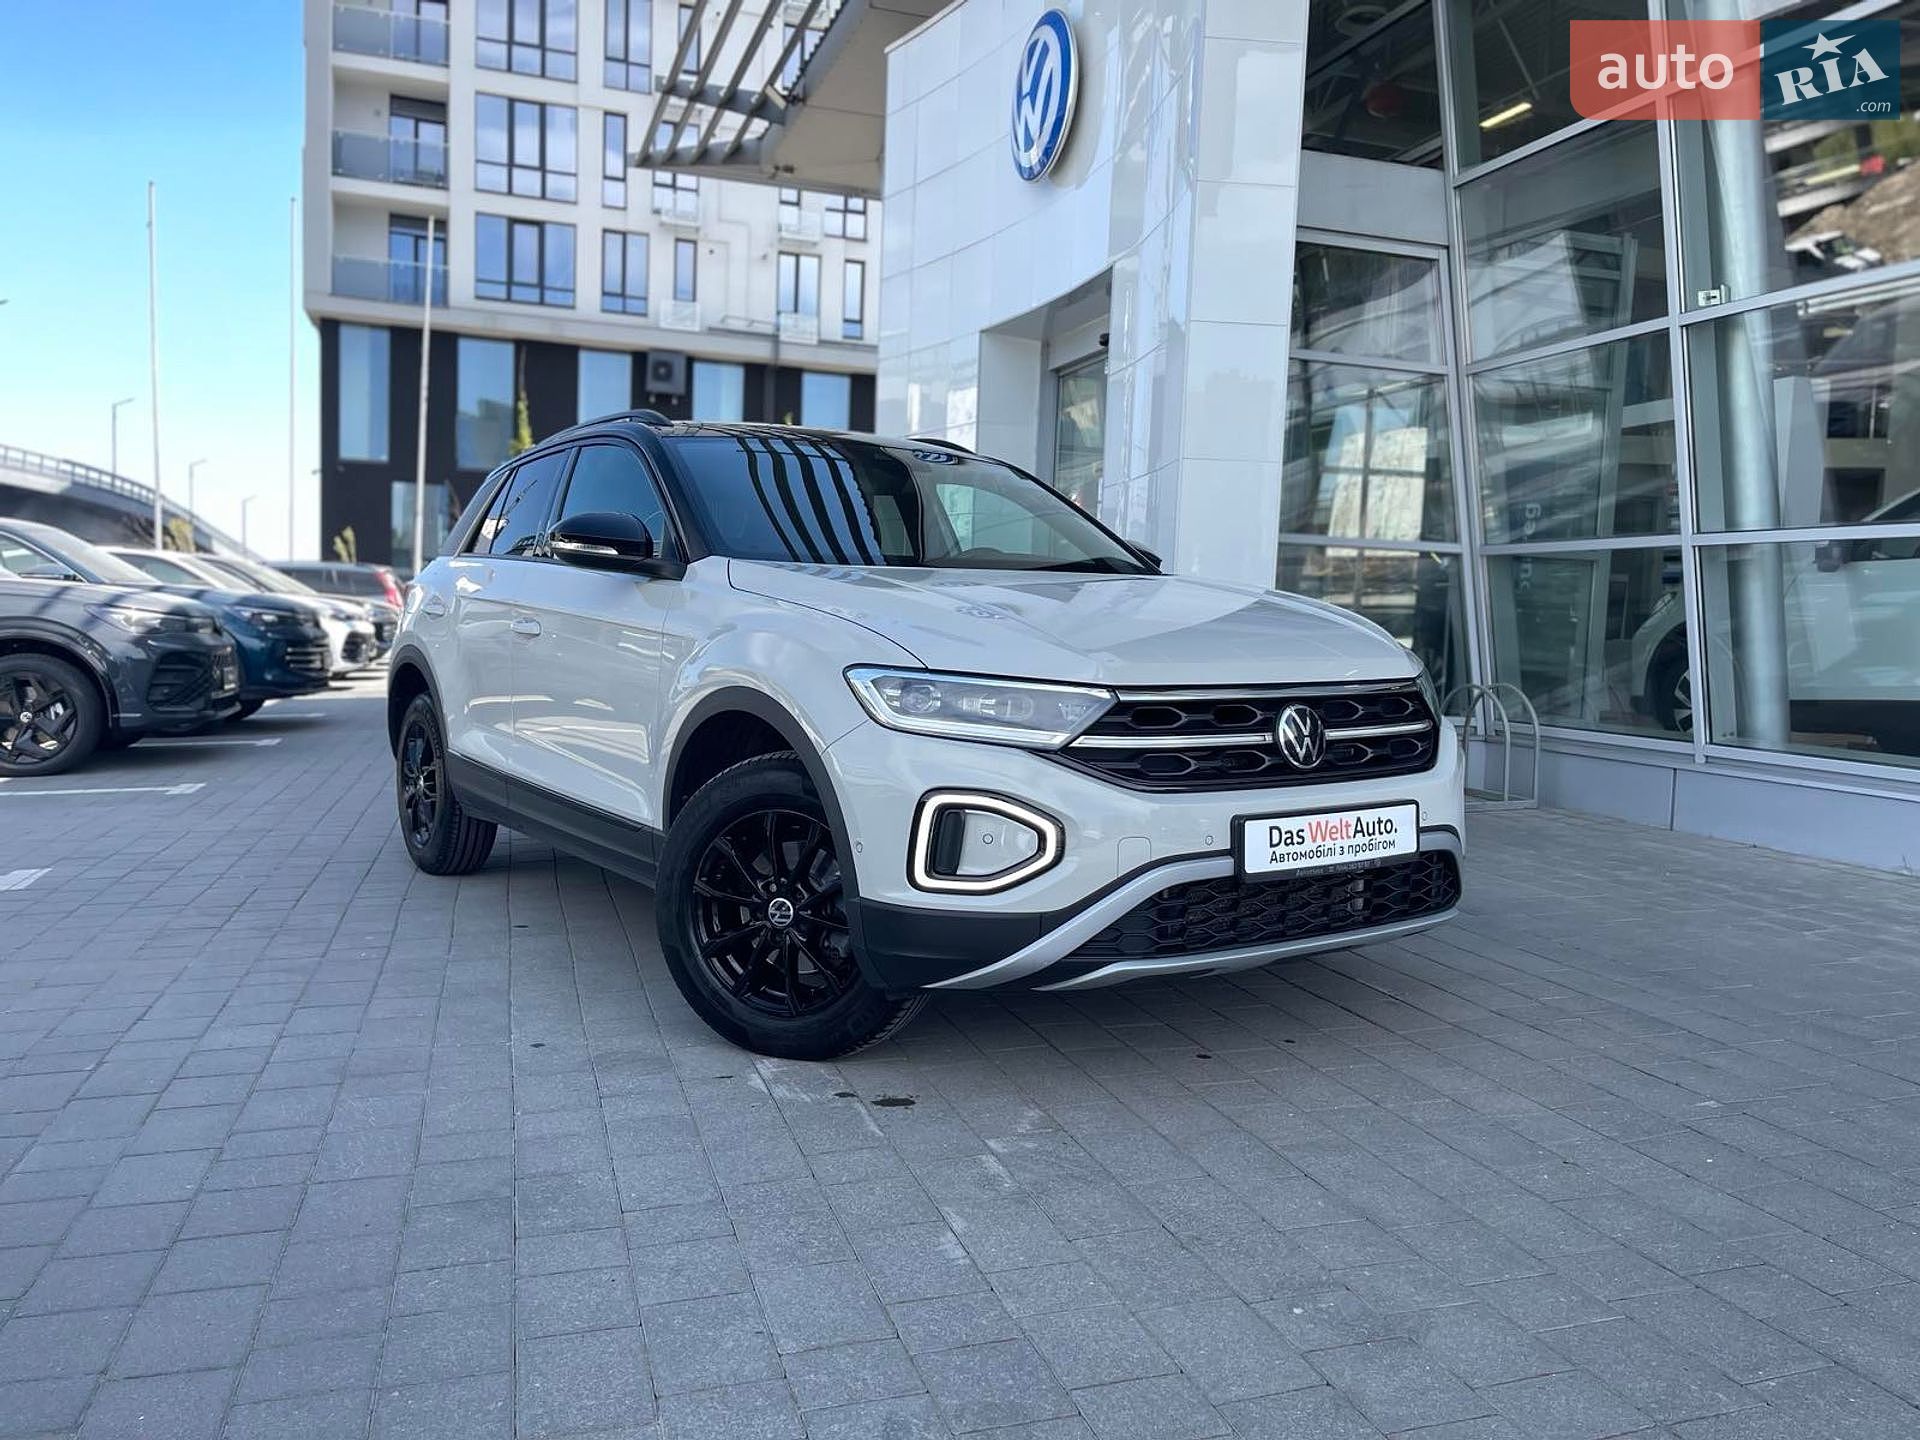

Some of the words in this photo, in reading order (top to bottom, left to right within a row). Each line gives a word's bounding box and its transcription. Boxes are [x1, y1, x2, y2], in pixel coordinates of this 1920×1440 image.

[1013, 21, 1066, 170] VW
[1279, 705, 1323, 766] VW
[1269, 825, 1306, 849] Das
[1269, 843, 1336, 865] Автомобілі
[1339, 845, 1345, 857] з
[1347, 838, 1396, 858] пробігом
